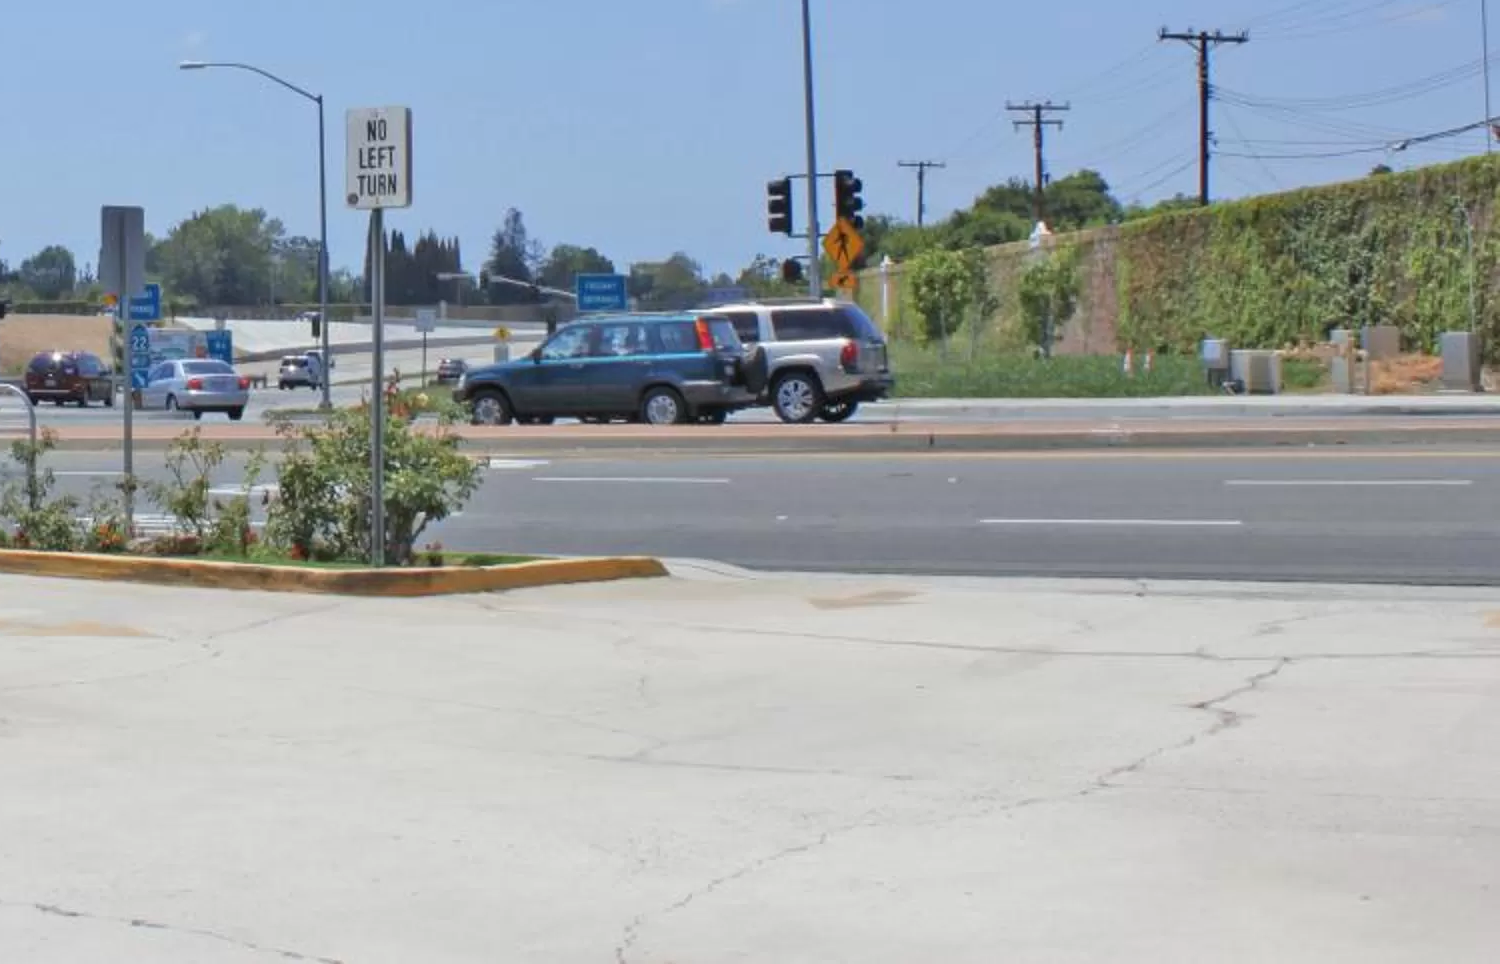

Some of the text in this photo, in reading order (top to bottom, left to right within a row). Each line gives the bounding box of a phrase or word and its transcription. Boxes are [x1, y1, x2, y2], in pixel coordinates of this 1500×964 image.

[367, 119, 387, 141] NO
[358, 145, 395, 169] LEFT
[356, 173, 397, 197] TURN
